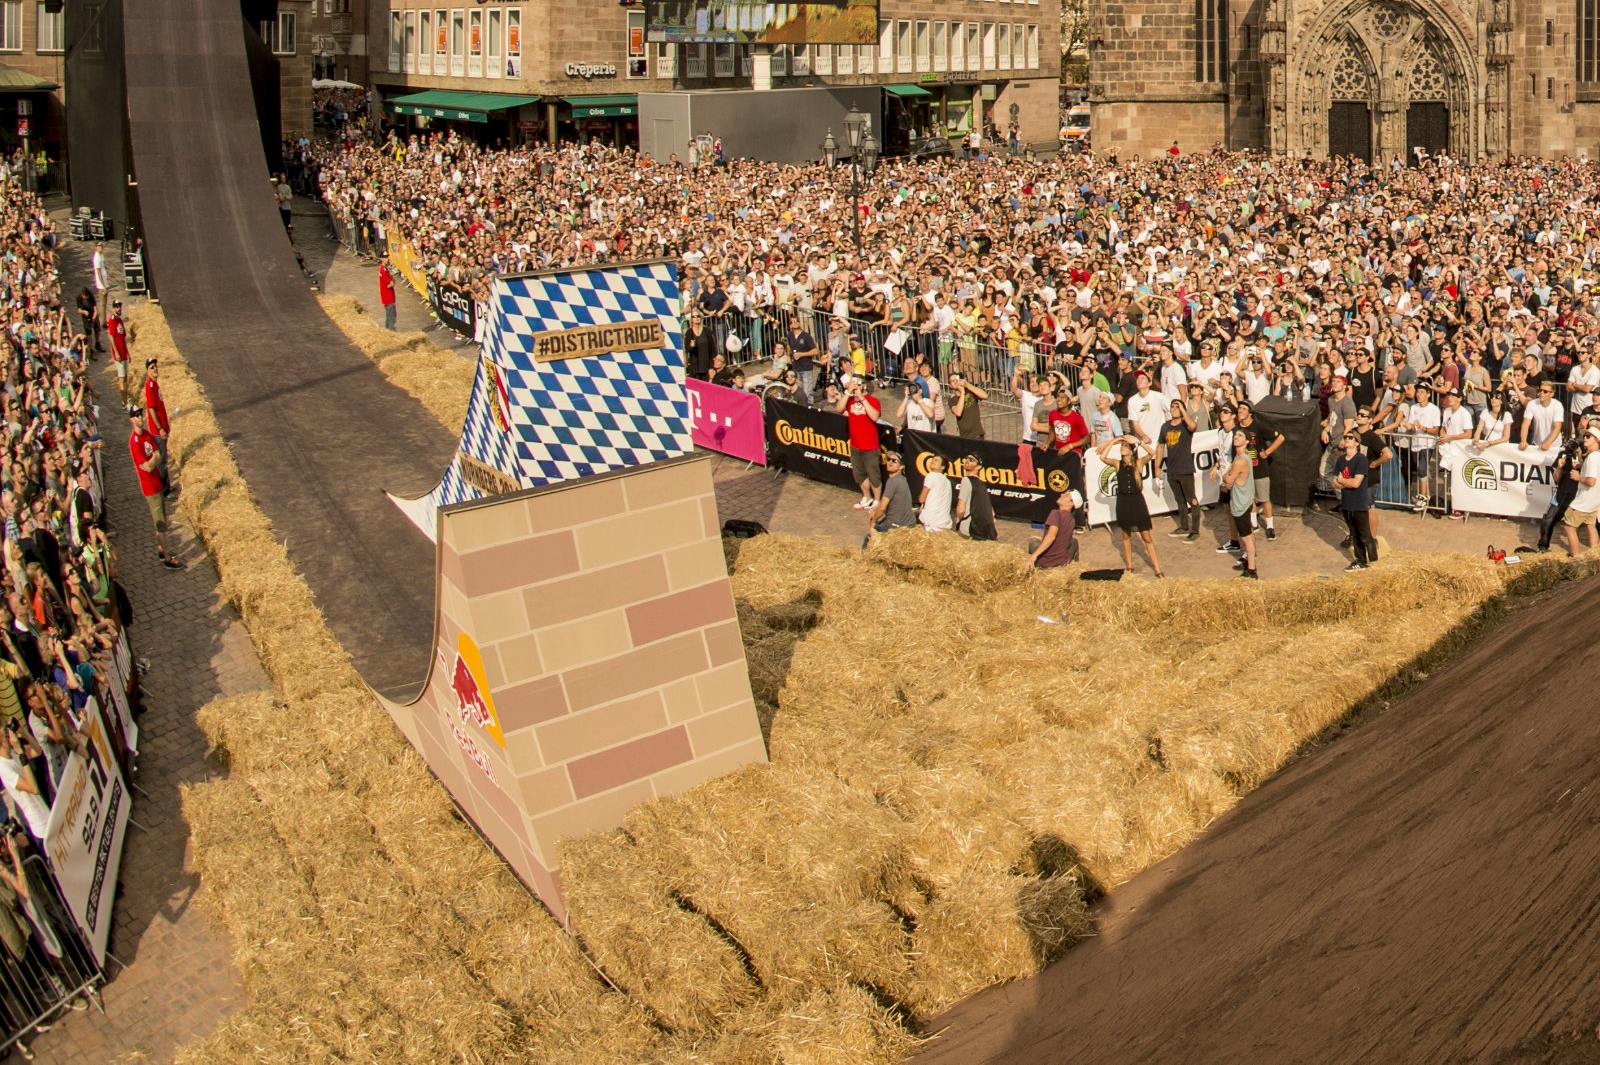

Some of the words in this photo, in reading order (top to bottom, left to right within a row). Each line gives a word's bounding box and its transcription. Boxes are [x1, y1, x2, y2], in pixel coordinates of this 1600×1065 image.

[564, 62, 617, 78] Crêperie
[440, 286, 469, 313] GoPro
[537, 323, 660, 357] #DISTRICTRIDE
[775, 419, 851, 457] Continent
[804, 451, 822, 460] GET
[822, 455, 839, 465] THE
[840, 460, 854, 469] GR
[987, 488, 1001, 496] HE
[1004, 490, 1030, 499] GRIP
[63, 760, 88, 835] RADIO
[80, 792, 100, 855] 92.9
